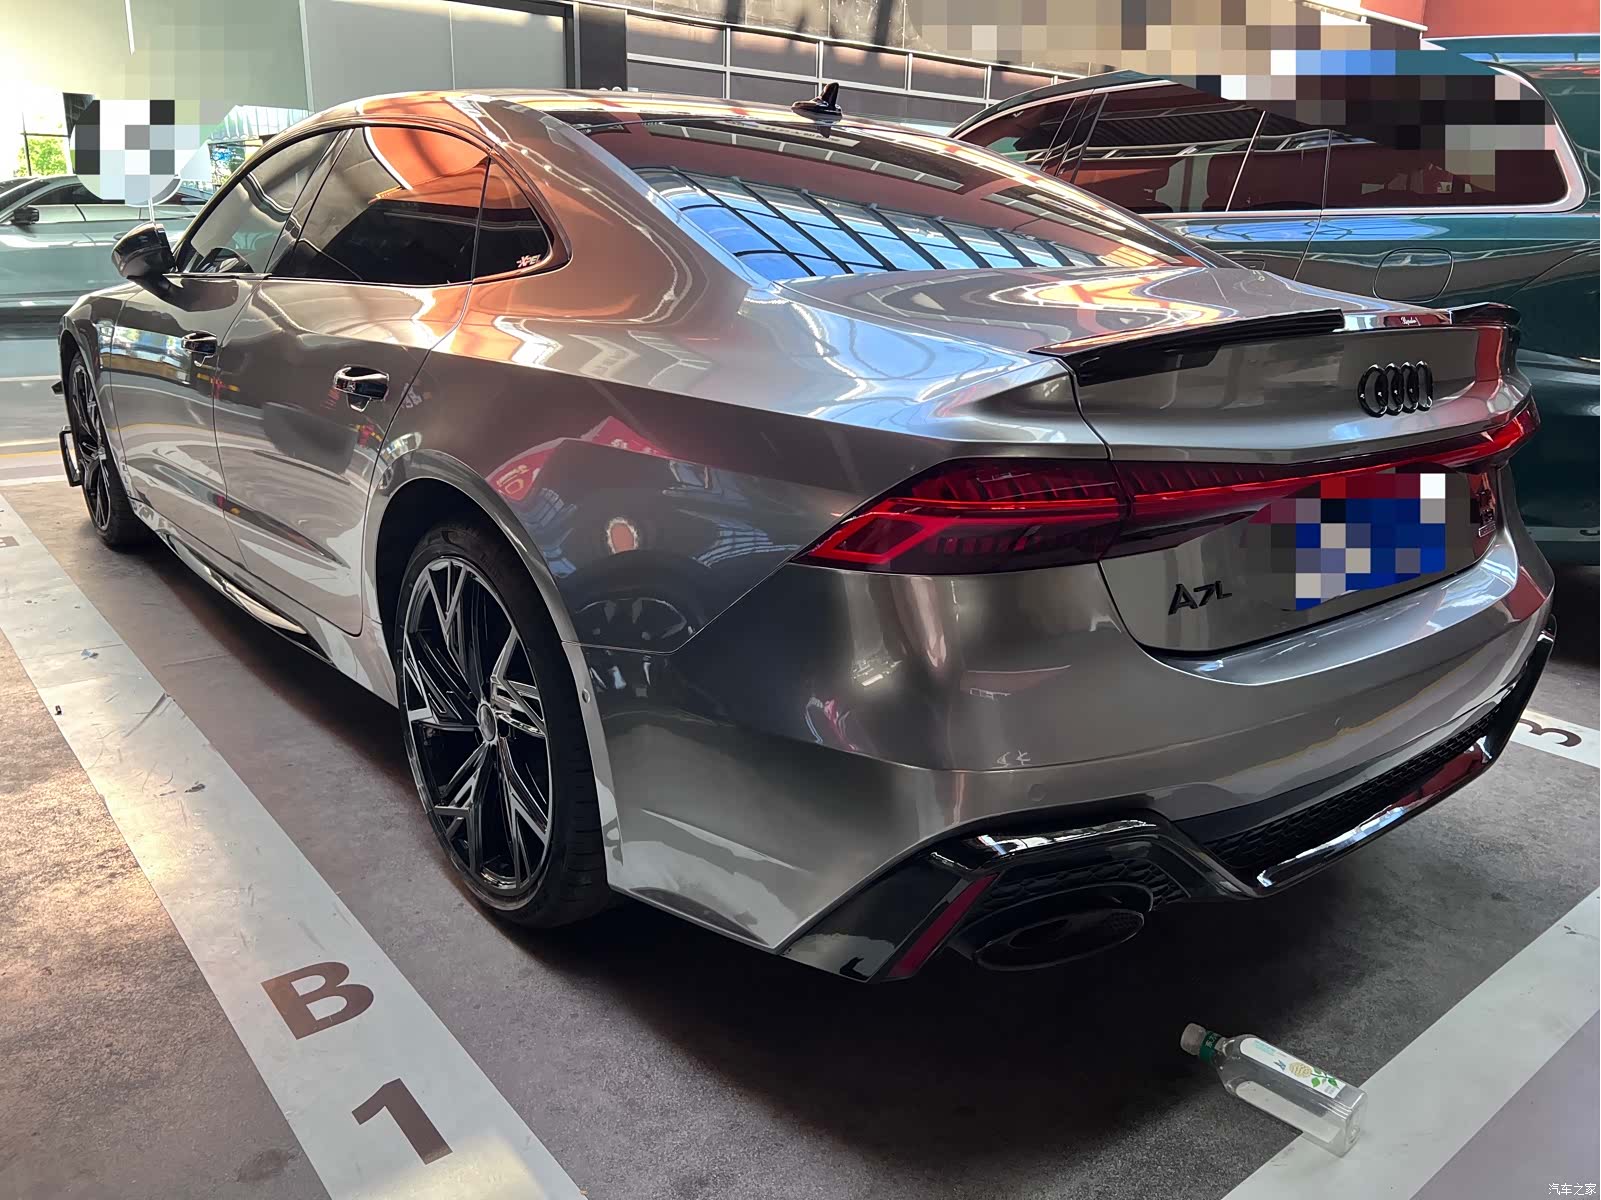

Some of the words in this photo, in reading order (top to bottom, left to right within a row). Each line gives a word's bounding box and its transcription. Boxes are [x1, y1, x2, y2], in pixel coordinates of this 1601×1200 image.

[1168, 580, 1232, 615] A7L
[1518, 719, 1582, 748] 3
[260, 961, 374, 1040] B
[351, 1078, 453, 1165] 1
